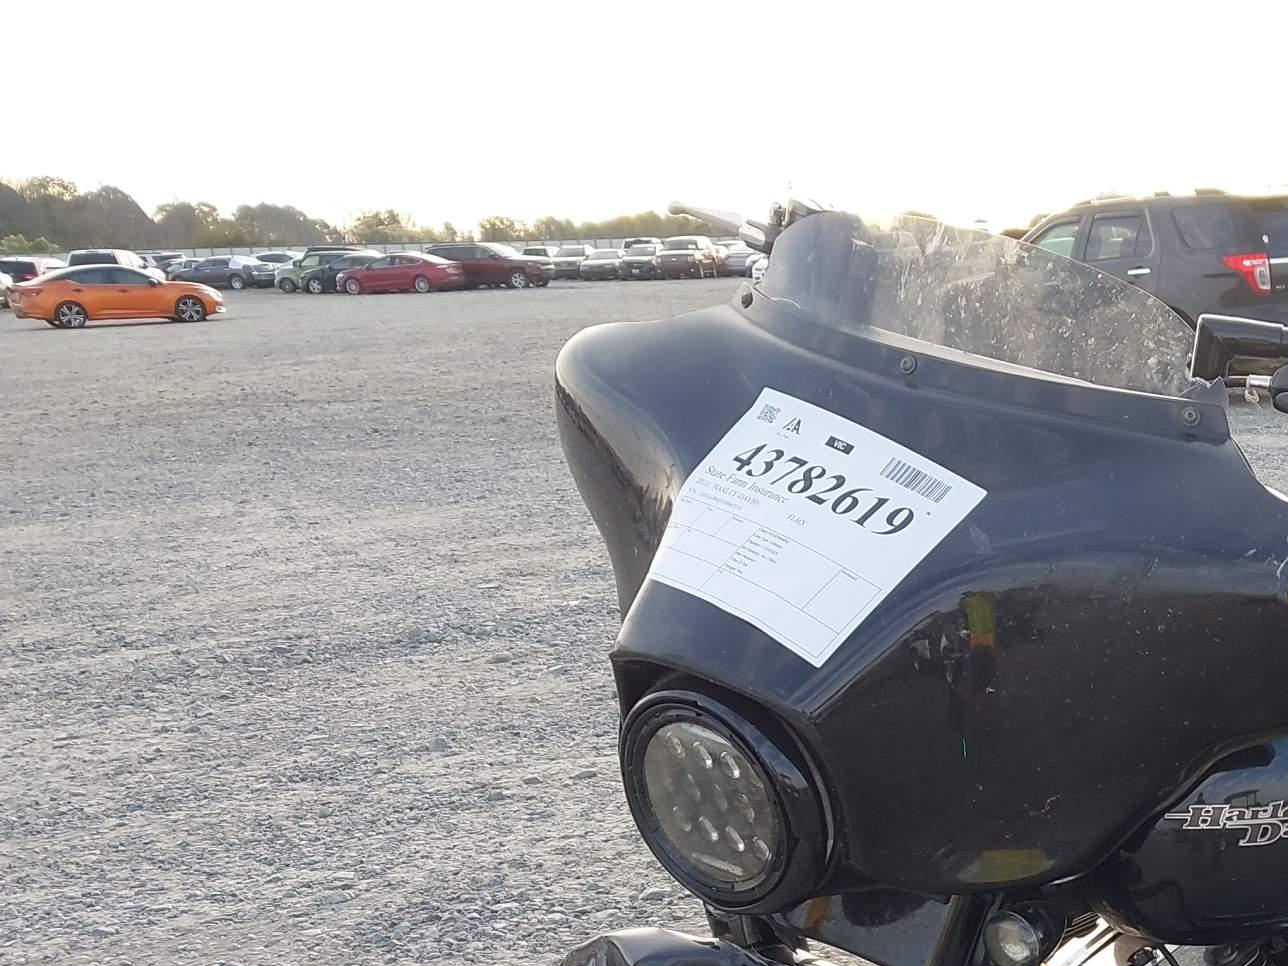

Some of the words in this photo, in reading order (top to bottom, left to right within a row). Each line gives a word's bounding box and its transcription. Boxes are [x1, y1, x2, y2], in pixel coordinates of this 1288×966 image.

[832, 439, 848, 450] VIC
[704, 465, 727, 480] State
[726, 471, 749, 489] Farm
[748, 481, 790, 504] Insurance
[732, 443, 915, 536] 43782619
